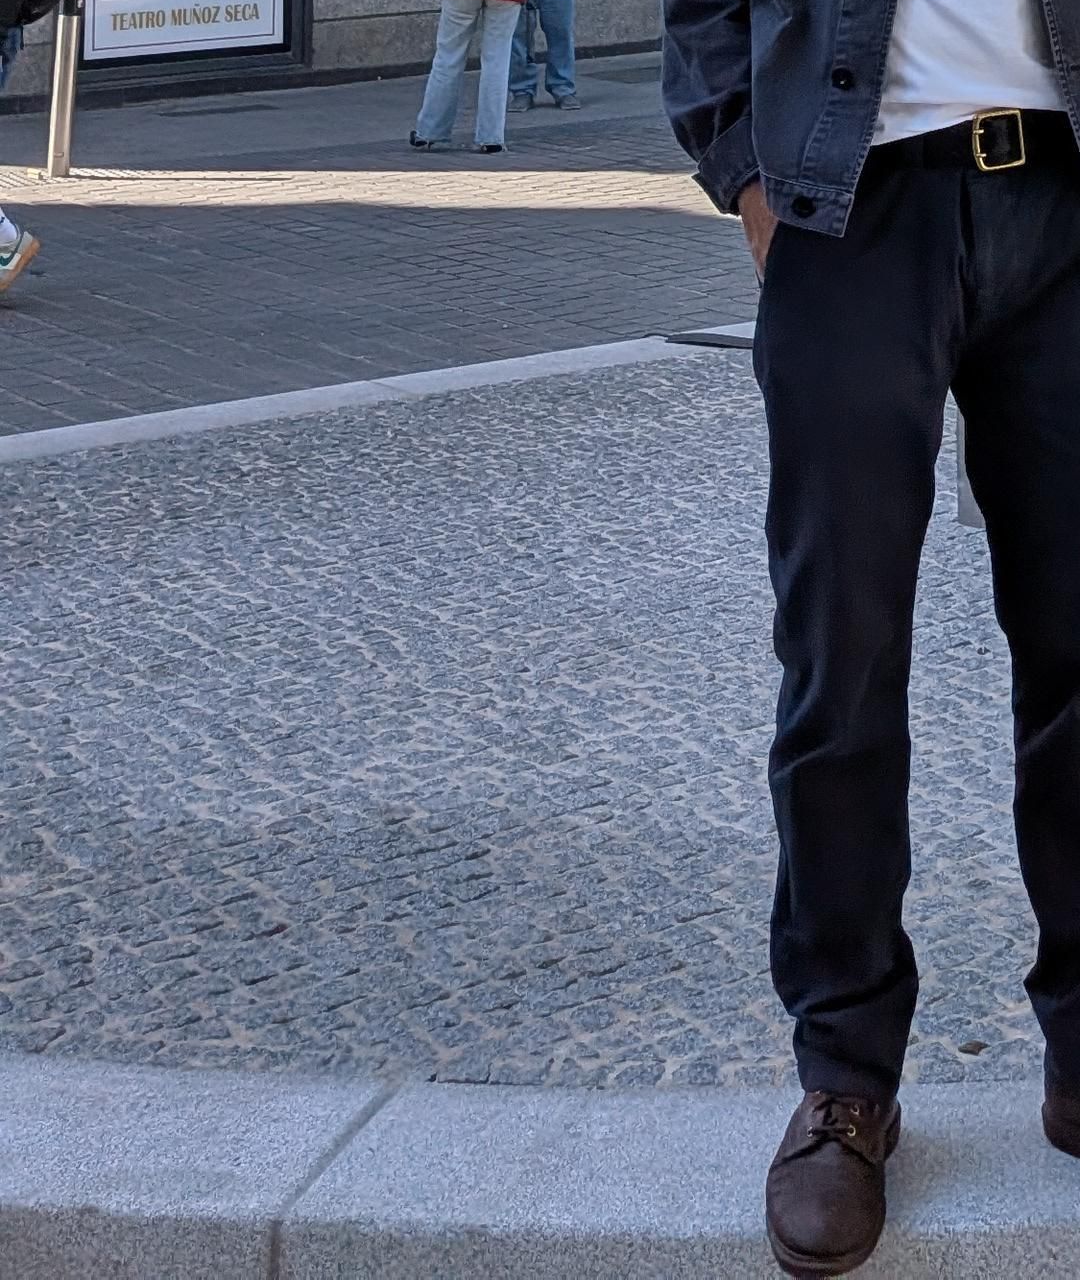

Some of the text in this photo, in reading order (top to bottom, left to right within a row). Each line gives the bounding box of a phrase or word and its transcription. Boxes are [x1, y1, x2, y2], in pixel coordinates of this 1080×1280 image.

[111, 3, 260, 31] TEATRO MUÑOZ SECA
